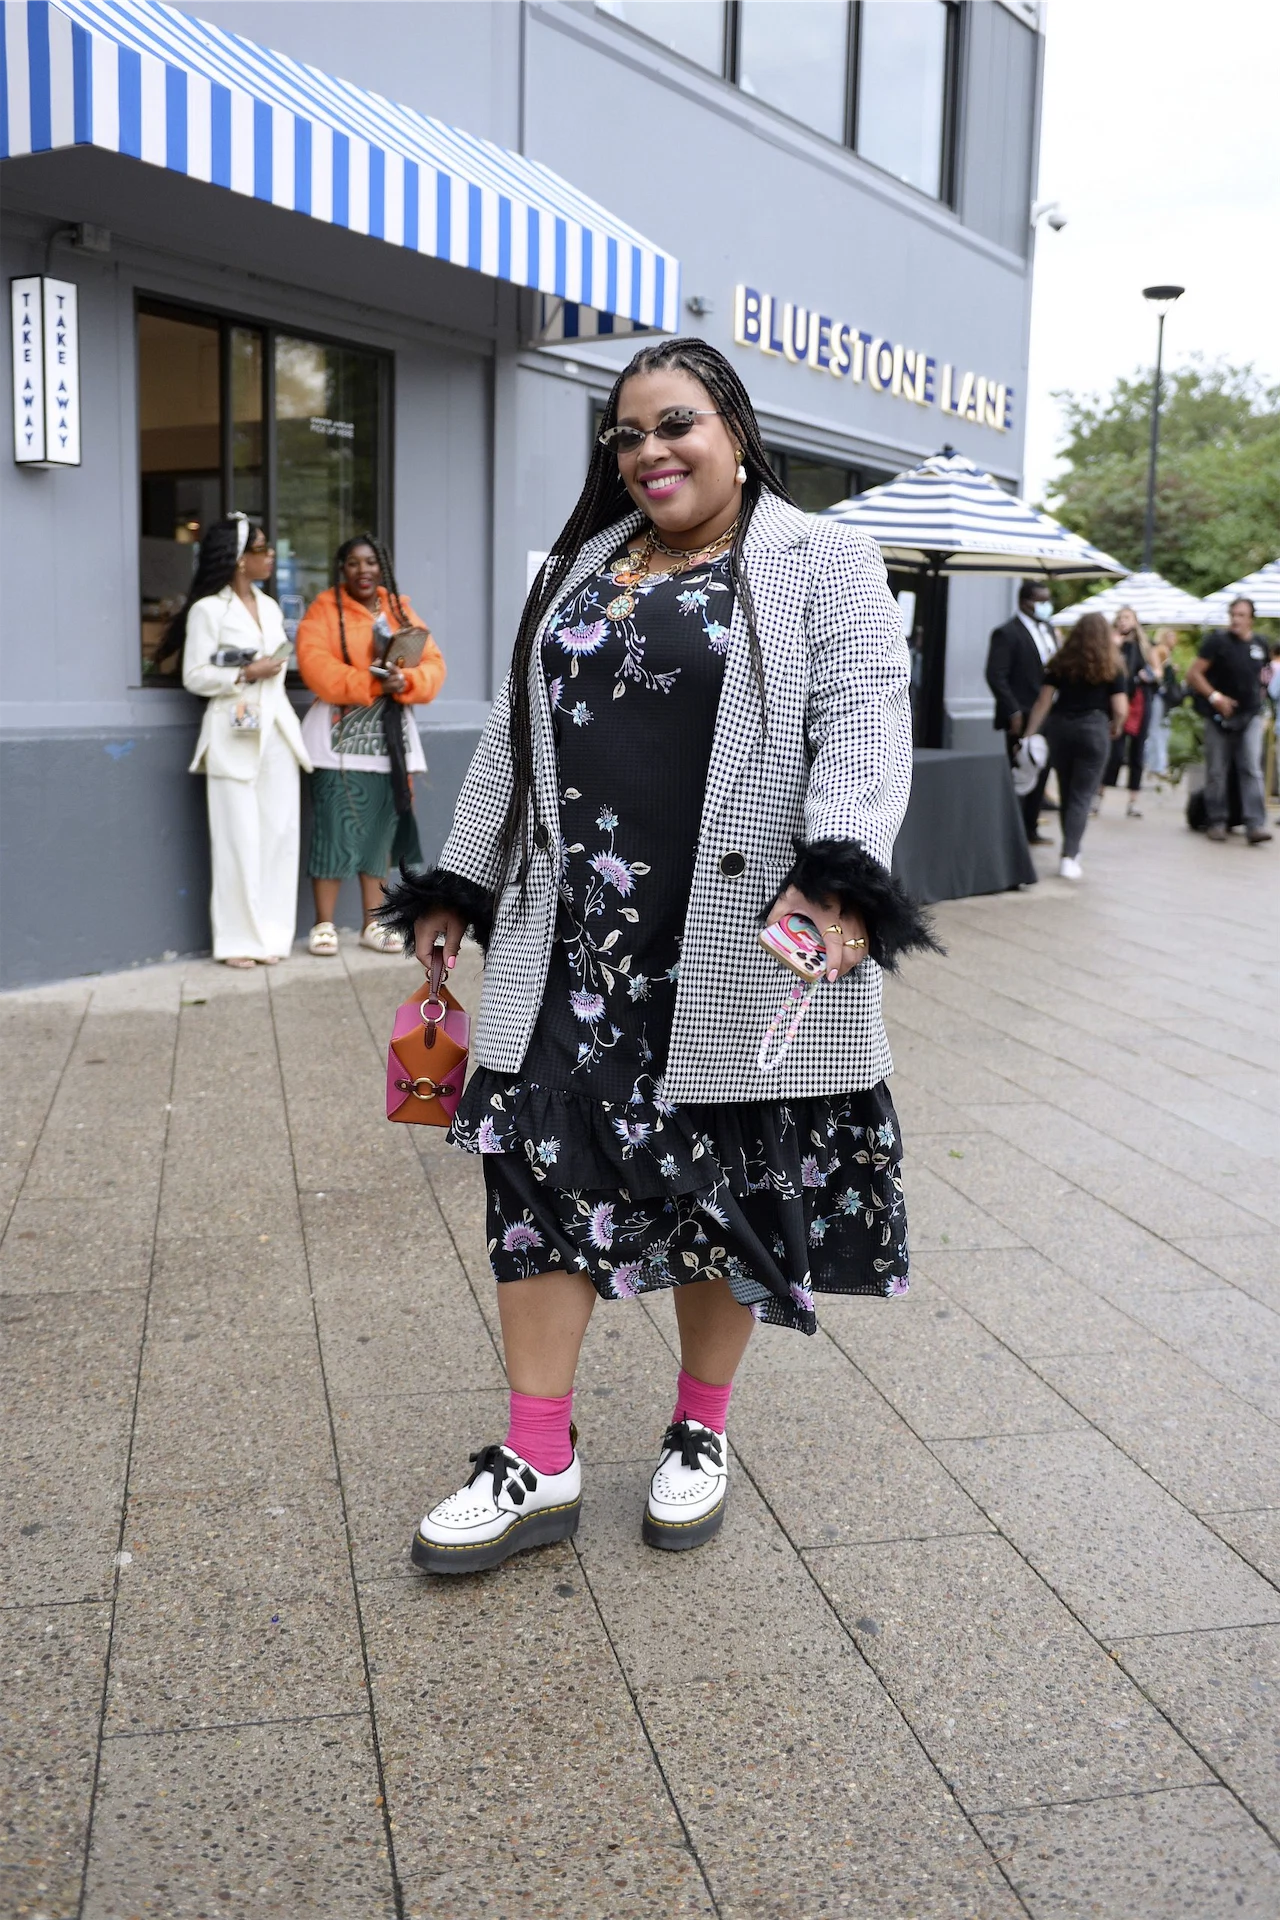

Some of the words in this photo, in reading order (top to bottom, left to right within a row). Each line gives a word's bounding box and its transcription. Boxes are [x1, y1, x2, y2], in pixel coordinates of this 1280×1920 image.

[23, 293, 32, 362] TAKE
[56, 295, 66, 364] TAKE
[734, 284, 936, 407] BLUESTONE
[941, 364, 1014, 432] LANE
[23, 378, 33, 446] AWAY
[56, 379, 69, 447] AWAY
